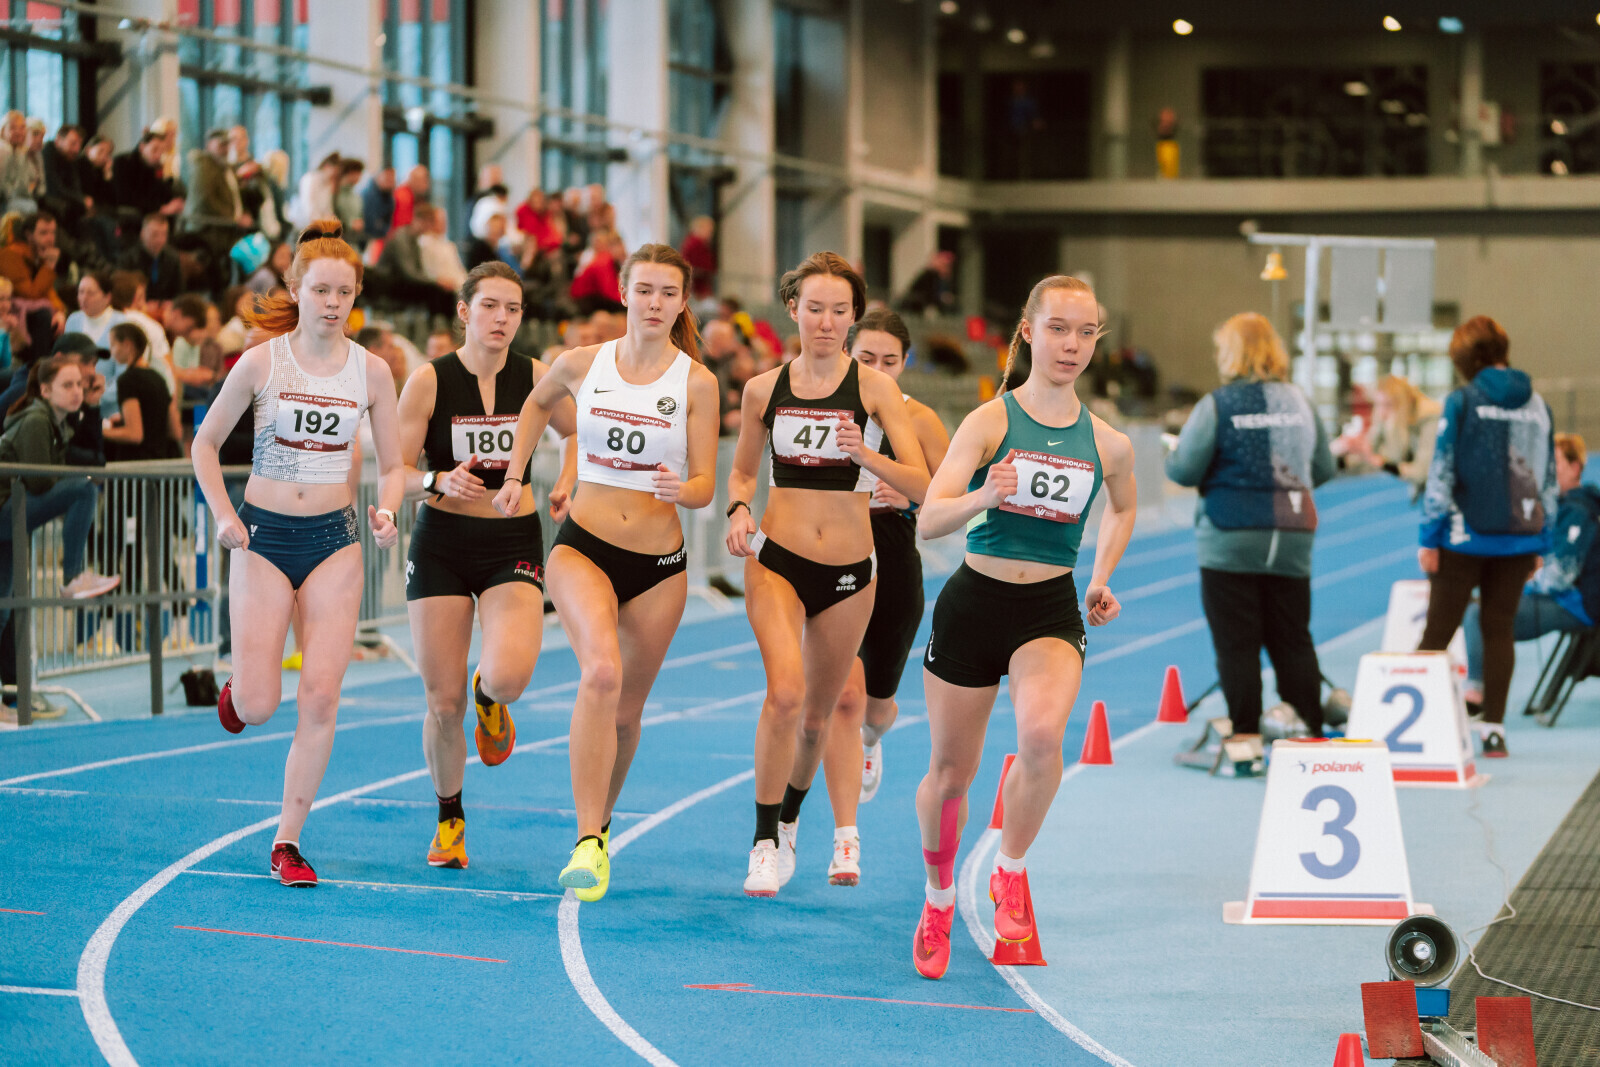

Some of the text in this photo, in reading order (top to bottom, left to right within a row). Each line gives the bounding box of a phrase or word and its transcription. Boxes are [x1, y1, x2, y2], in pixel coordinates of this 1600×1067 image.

[294, 409, 340, 436] 192
[466, 430, 514, 454] 180
[606, 427, 646, 455] 80
[793, 425, 831, 449] 47
[1030, 471, 1070, 503] 62
[657, 551, 682, 566] NIKE
[1382, 684, 1425, 753] 2
[1312, 761, 1365, 775] polanik
[1299, 784, 1361, 880] 3
